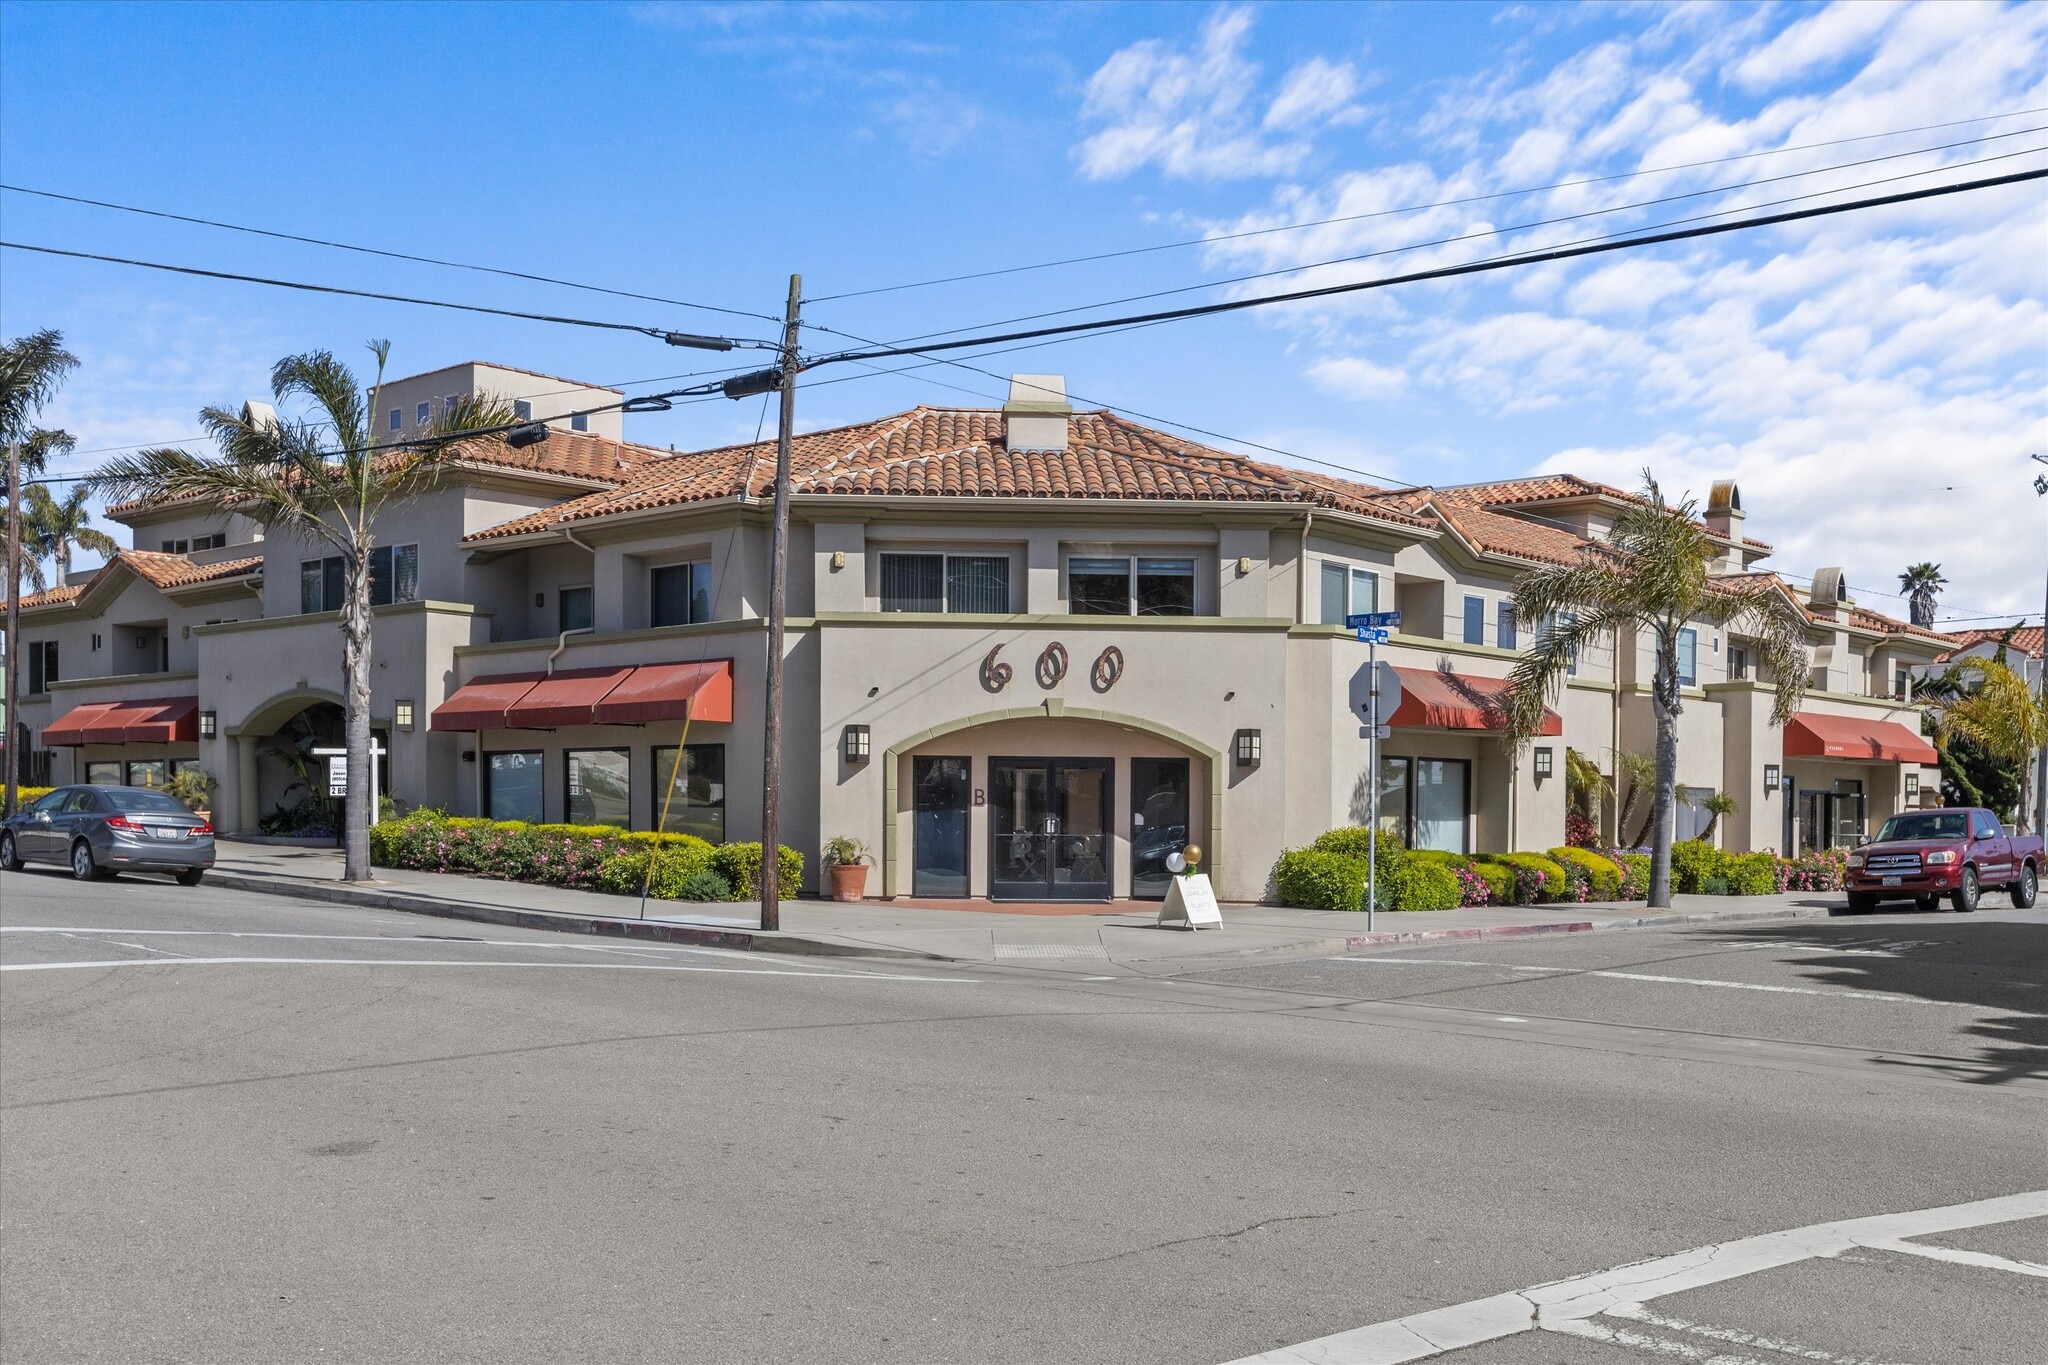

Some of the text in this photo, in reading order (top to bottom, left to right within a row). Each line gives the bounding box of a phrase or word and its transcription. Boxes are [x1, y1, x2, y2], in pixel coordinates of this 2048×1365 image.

[1349, 616, 1368, 626] Morro
[1370, 614, 1382, 626] Bay
[1360, 627, 1376, 640] Shasta
[987, 641, 1124, 685] 600
[975, 789, 985, 805] B
